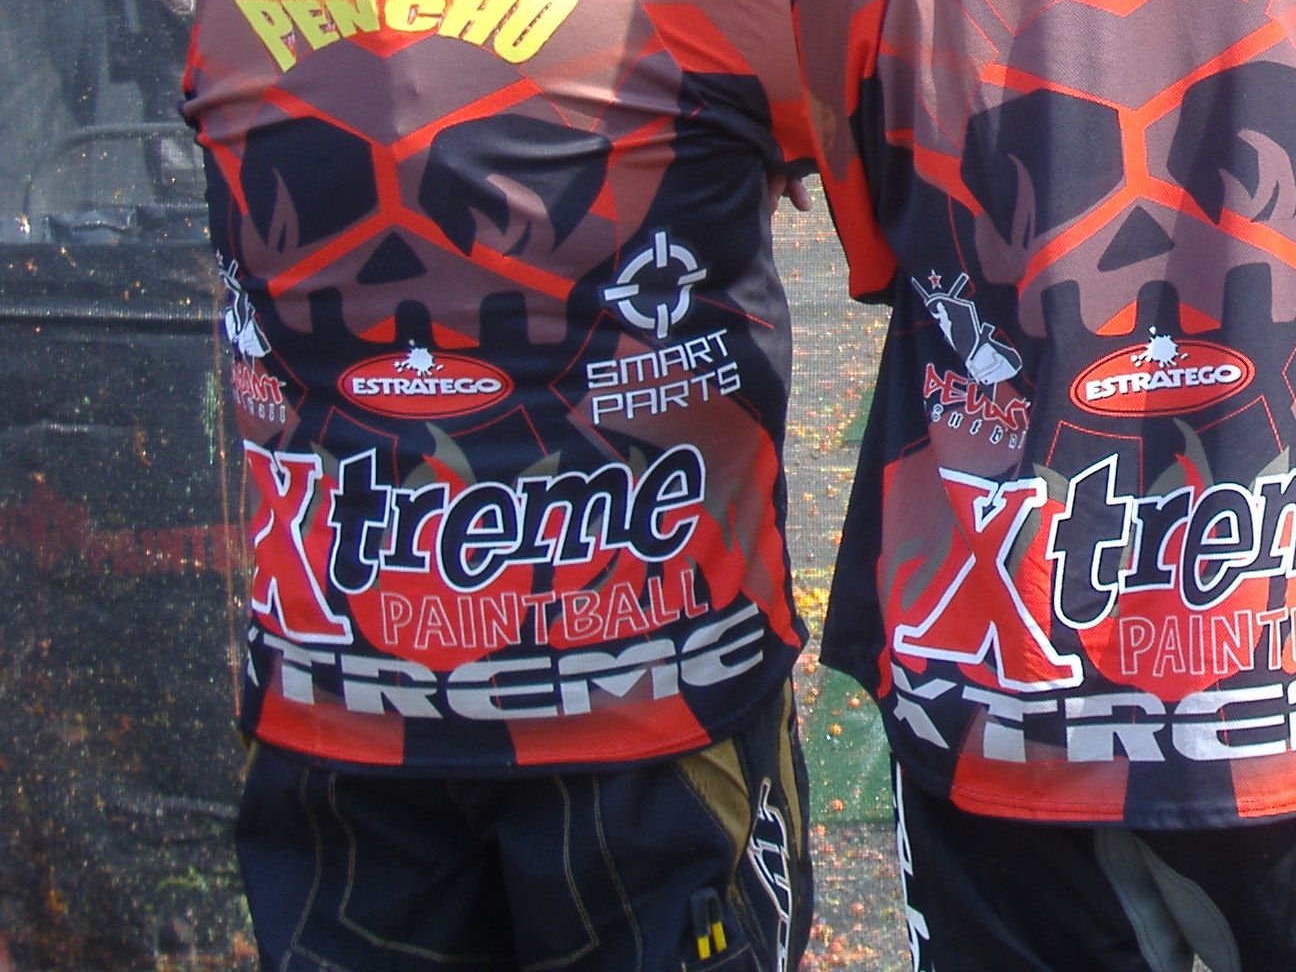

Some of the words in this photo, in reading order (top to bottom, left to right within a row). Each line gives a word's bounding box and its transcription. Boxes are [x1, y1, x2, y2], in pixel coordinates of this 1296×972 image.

[351, 377, 503, 396] ESTRATEGO
[586, 328, 729, 389] SMART
[1085, 364, 1242, 401] ESTRATEGO
[591, 361, 742, 425] PARTS
[89, 524, 256, 576] PAINTB
[243, 443, 706, 645] Xtreme
[380, 569, 709, 649] PAINTBALL
[246, 602, 765, 720] TREME
